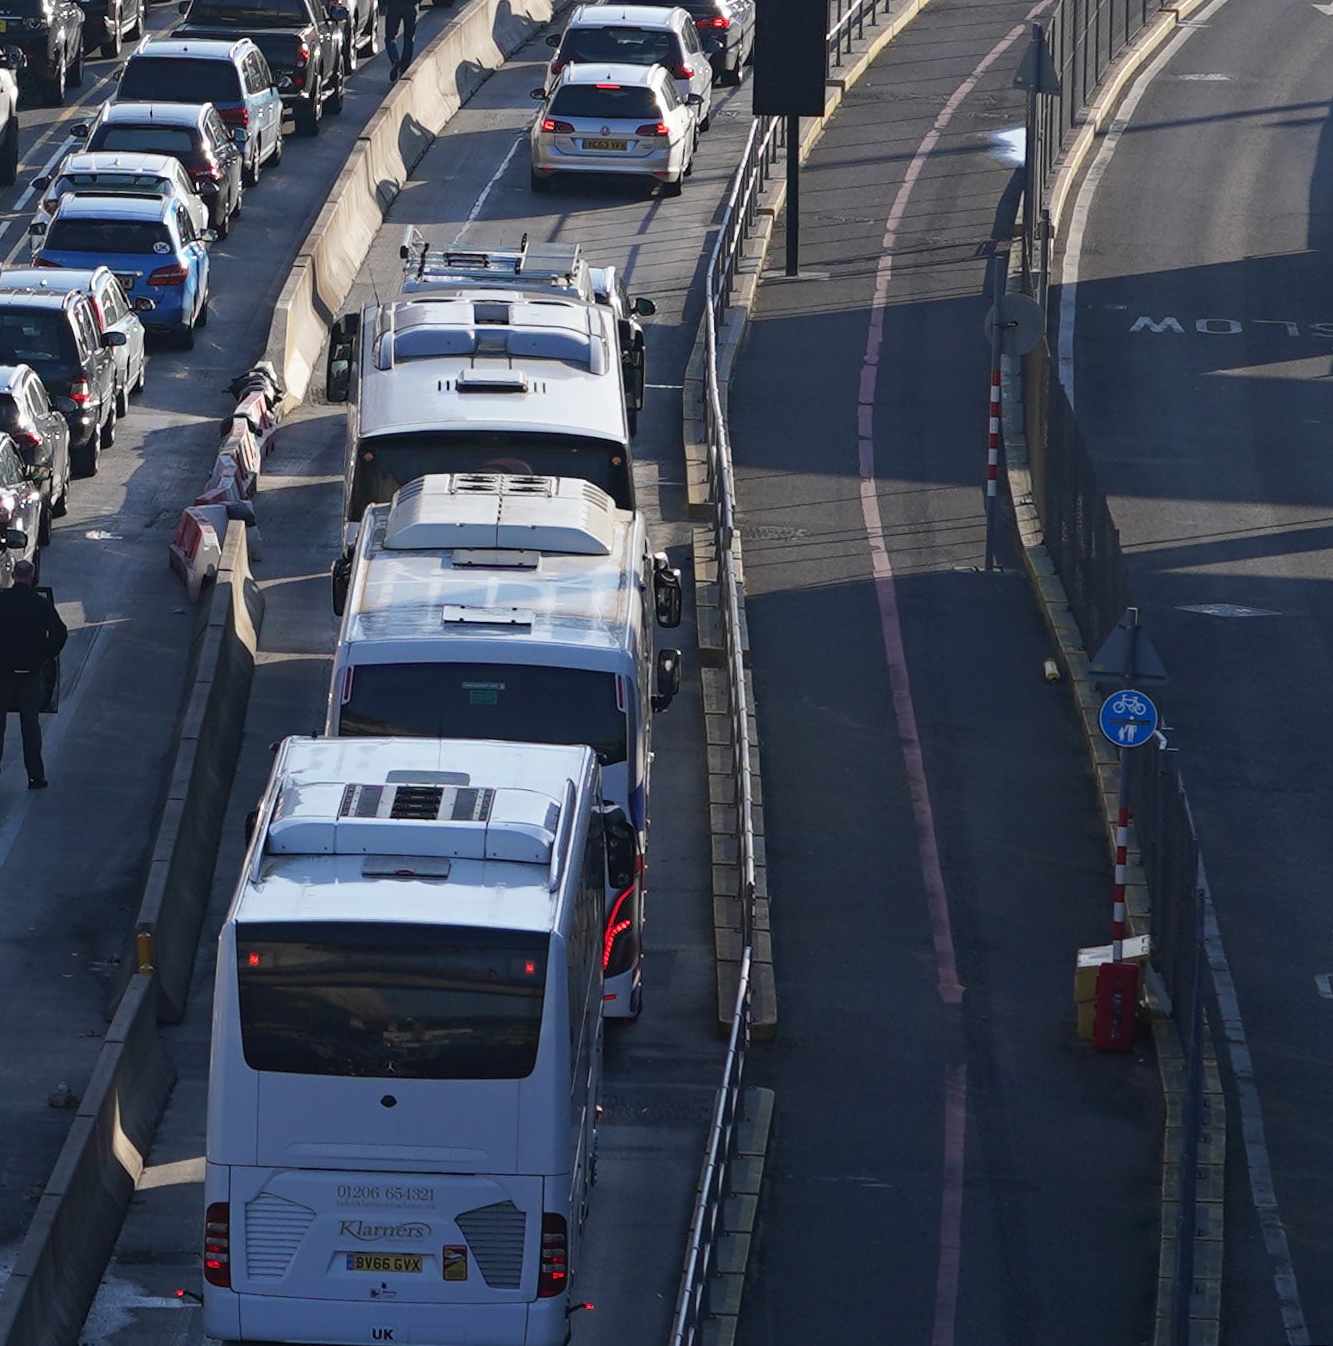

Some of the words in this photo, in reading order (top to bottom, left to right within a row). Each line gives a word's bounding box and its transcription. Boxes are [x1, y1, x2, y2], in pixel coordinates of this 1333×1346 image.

[337, 1184, 380, 1199] 01206
[384, 1184, 435, 1199] 654321
[338, 1220, 426, 1240] Klarners
[354, 1254, 393, 1271] BV66
[394, 1256, 421, 1272] GVX
[372, 1328, 394, 1341] UK
